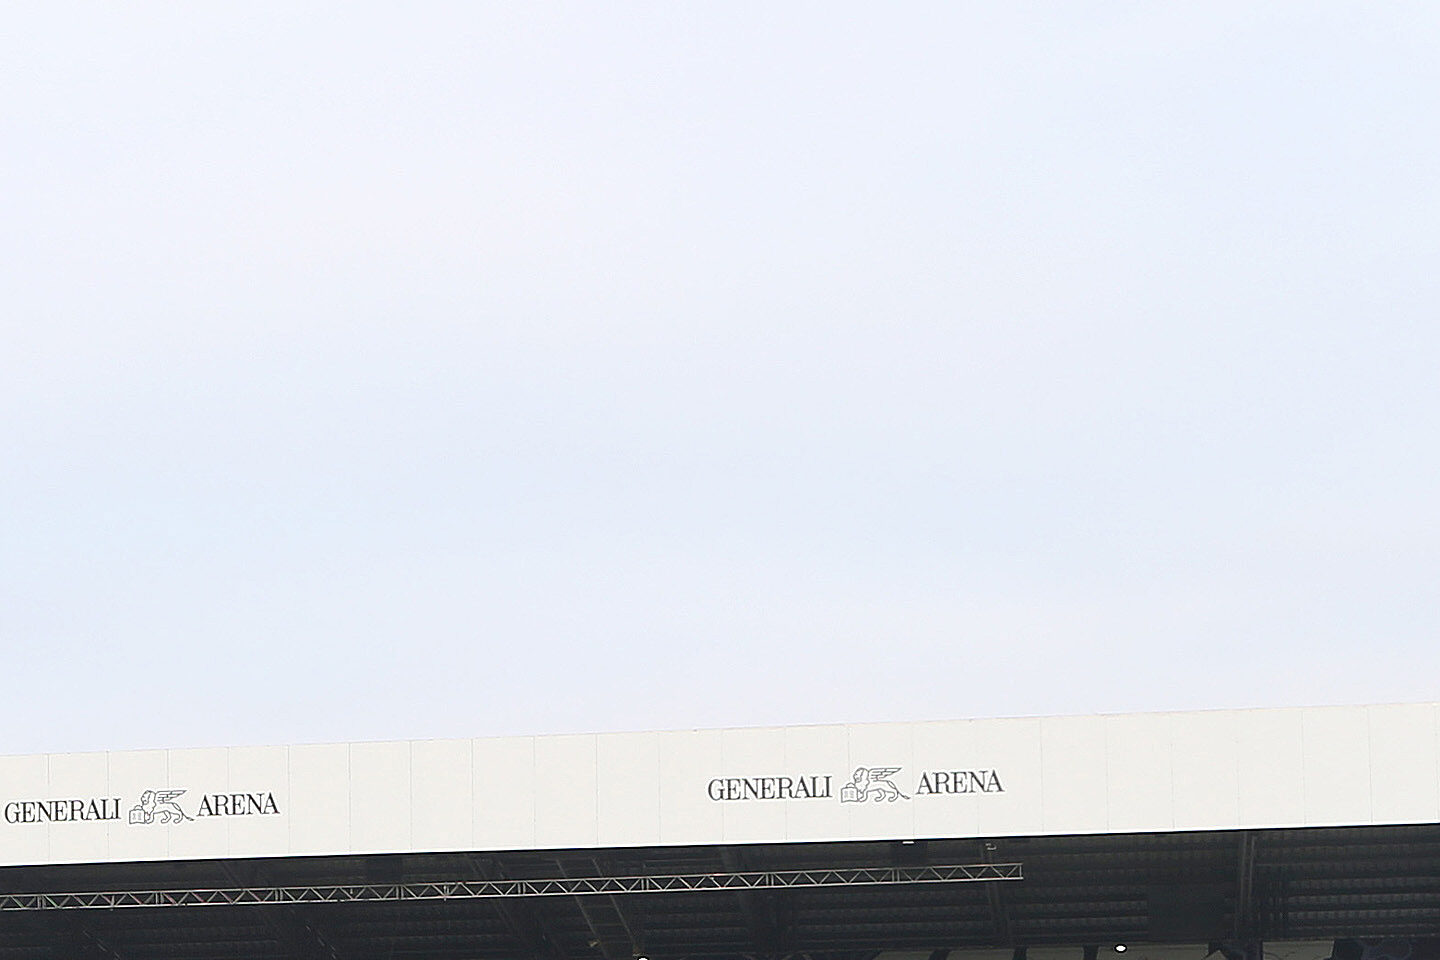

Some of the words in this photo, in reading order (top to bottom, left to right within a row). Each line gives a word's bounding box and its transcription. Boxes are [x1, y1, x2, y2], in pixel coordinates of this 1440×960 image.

[708, 776, 832, 800] GENERALI
[917, 771, 1003, 794] ARENA
[5, 799, 120, 823] GENERALI
[197, 793, 280, 816] ARENA
